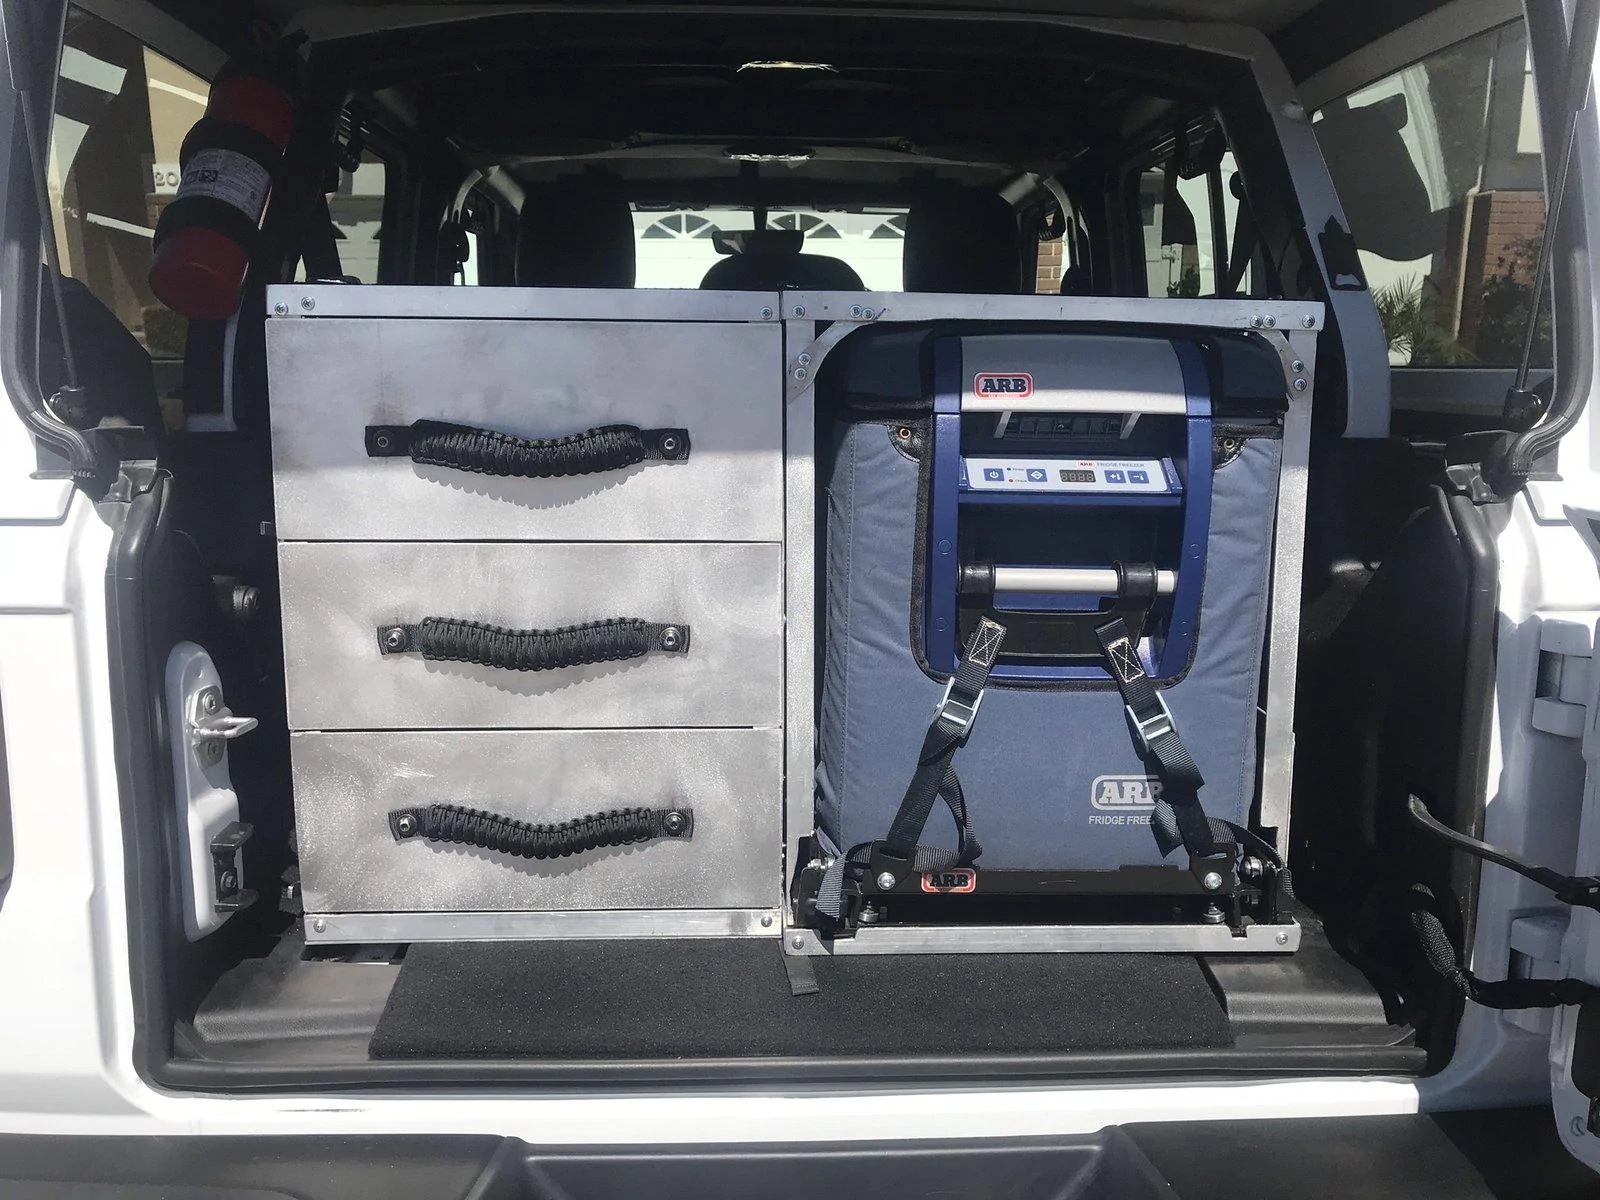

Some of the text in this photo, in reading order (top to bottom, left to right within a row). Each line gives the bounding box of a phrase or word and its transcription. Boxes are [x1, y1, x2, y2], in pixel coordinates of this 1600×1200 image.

[981, 378, 1027, 393] ARB
[1088, 815, 1155, 825] FRIDGE FREE
[929, 873, 969, 887] ARB
